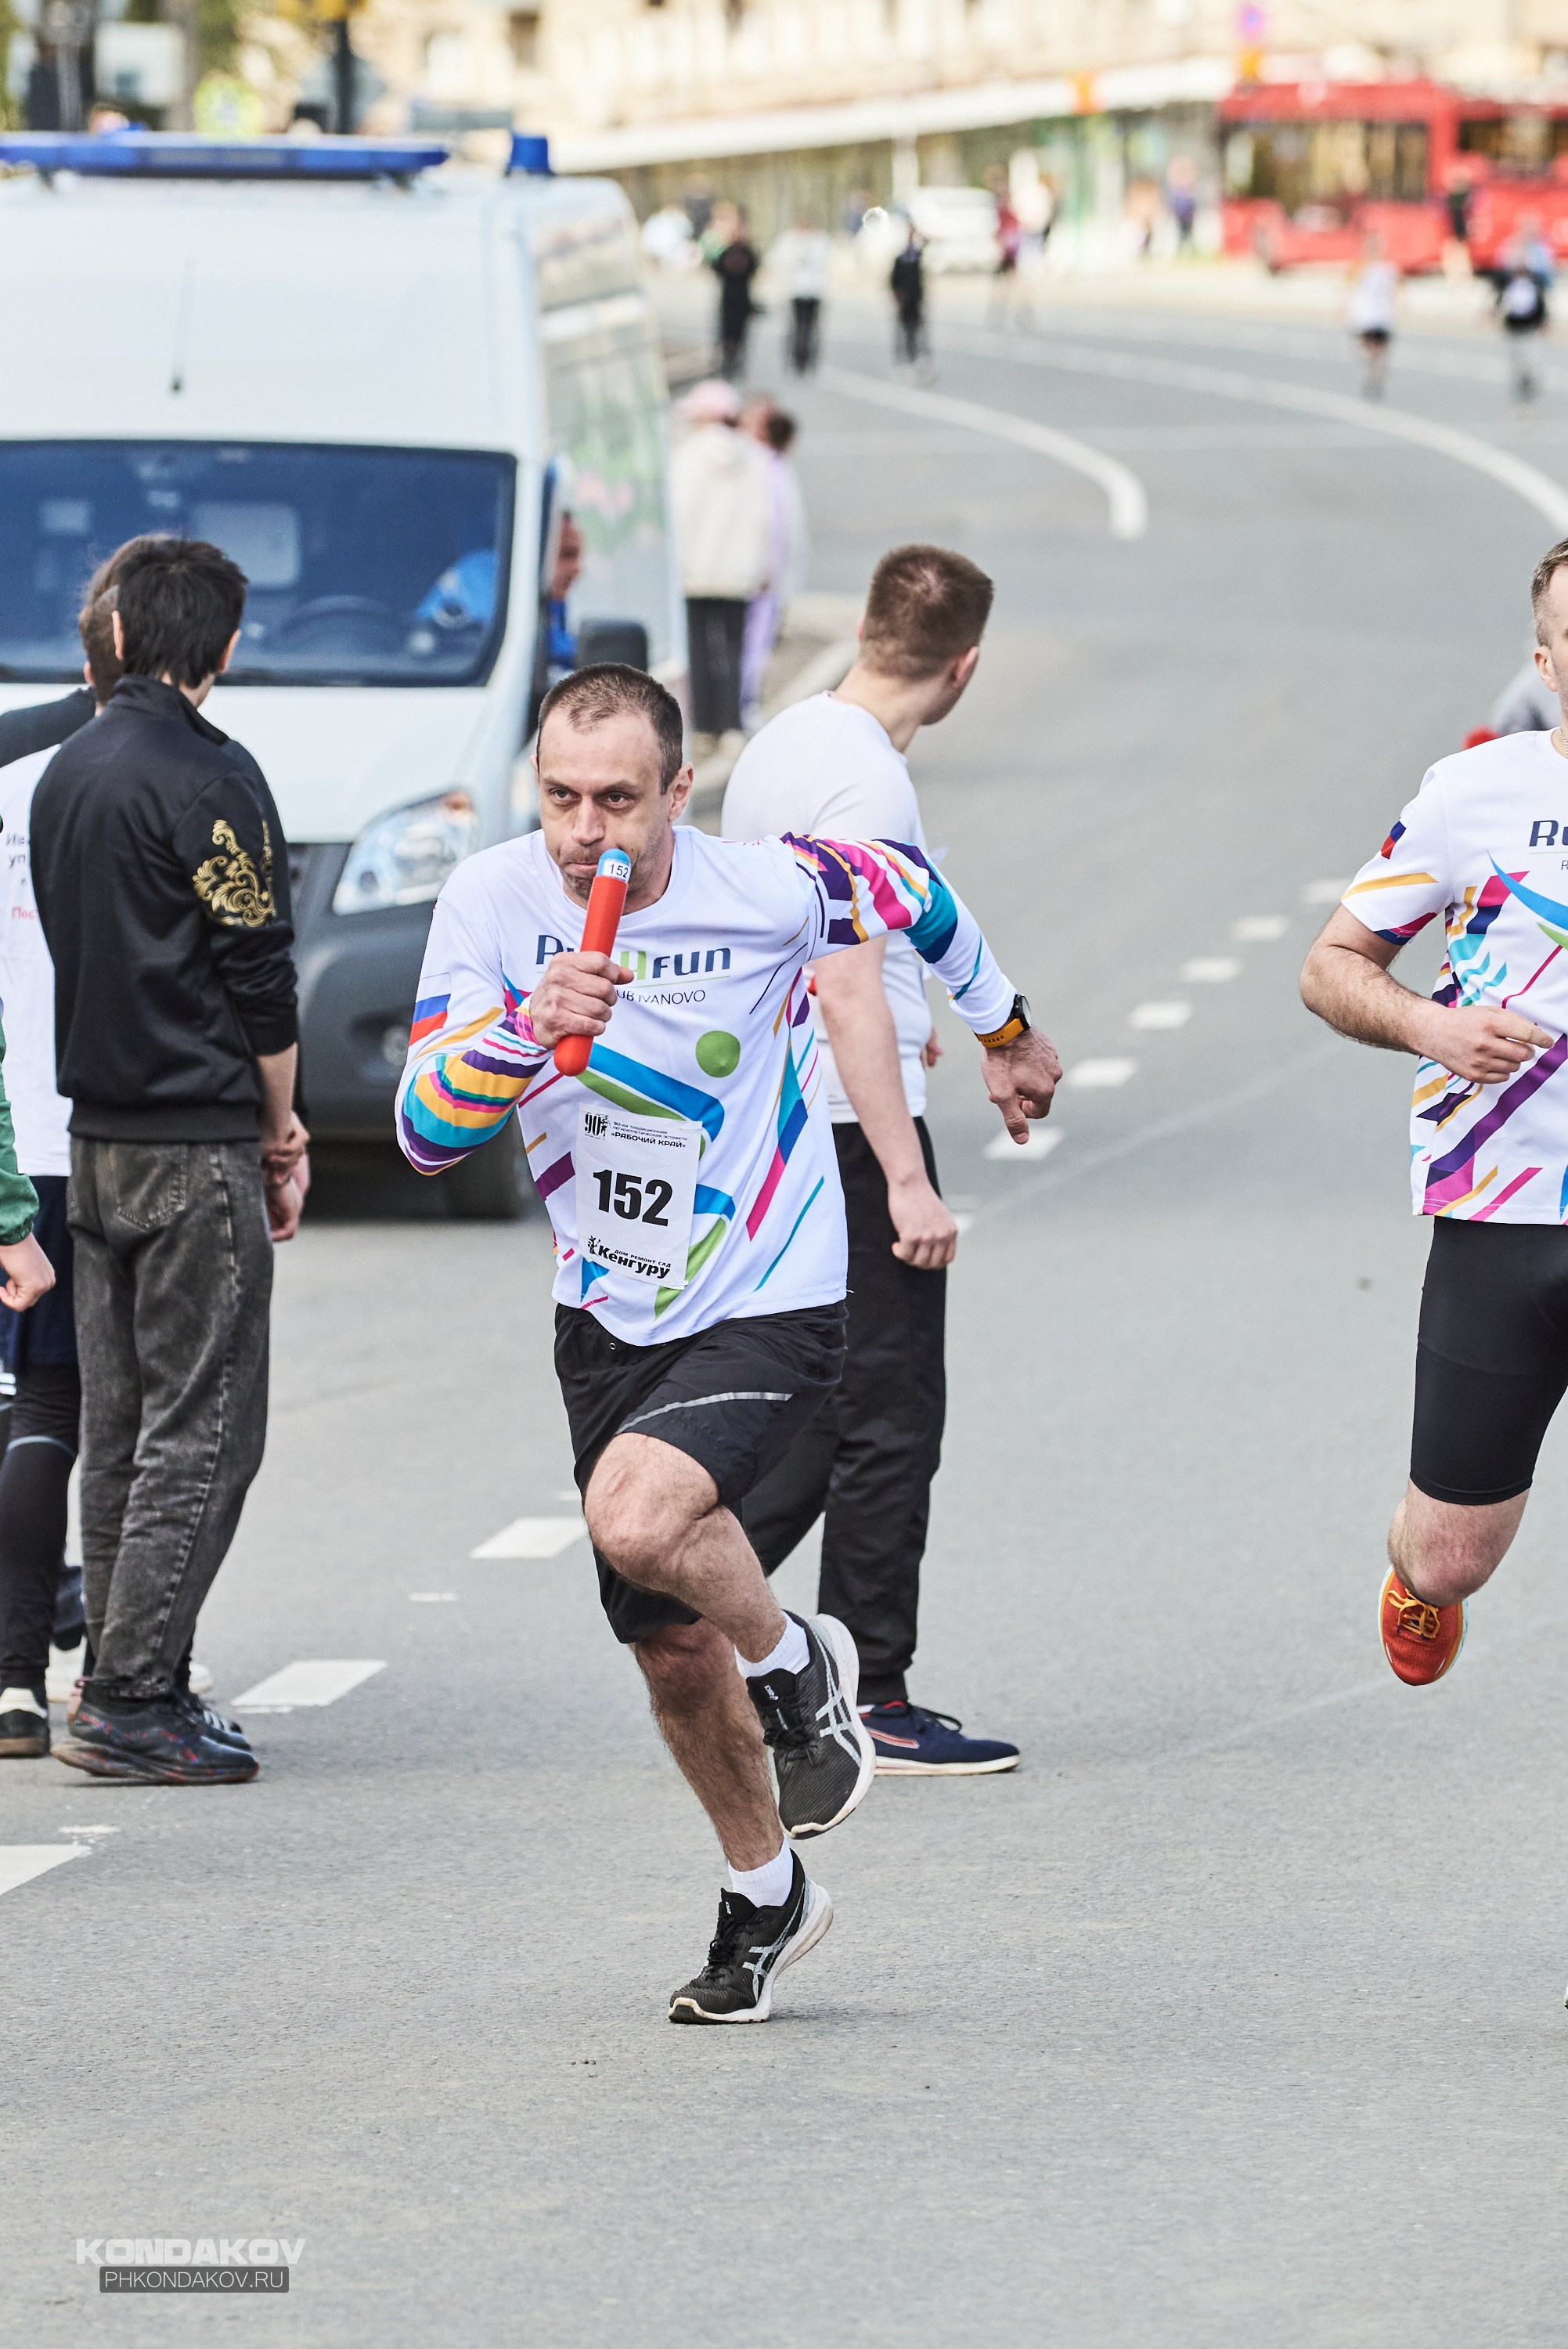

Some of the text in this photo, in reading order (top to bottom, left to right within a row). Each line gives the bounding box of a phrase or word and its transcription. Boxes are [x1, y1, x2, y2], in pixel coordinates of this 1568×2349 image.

[610, 864, 629, 879] 152
[638, 990, 706, 1005] IVANOVO
[585, 1112, 601, 1136] 90
[611, 1131, 656, 1144] «РАБОЧИЙ
[658, 1138, 686, 1148] КРАЙ»
[593, 1169, 673, 1226] 152
[598, 1245, 671, 1279] Кенгуру
[630, 1254, 656, 1264] РЕМОНТ
